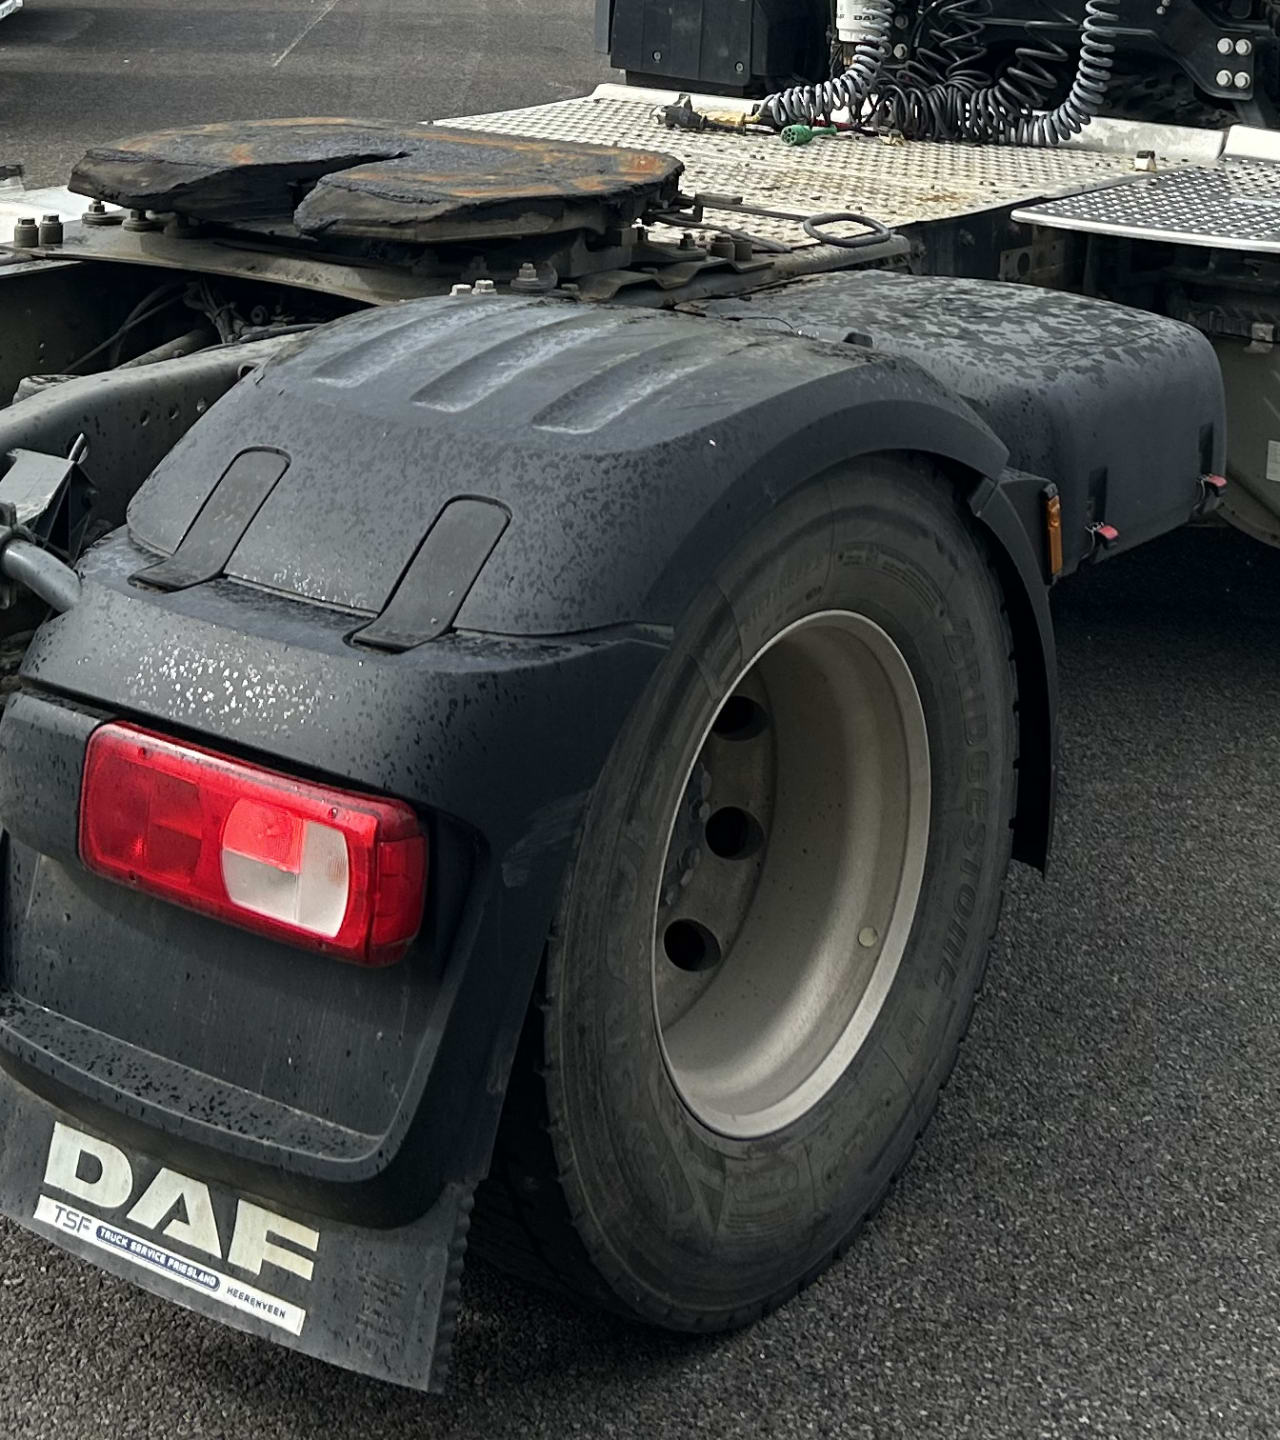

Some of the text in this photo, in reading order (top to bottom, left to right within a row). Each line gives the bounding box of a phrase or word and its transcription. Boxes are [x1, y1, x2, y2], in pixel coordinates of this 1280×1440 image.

[43, 1121, 320, 1282] DAF
[54, 1205, 287, 1319] TSF TRUCK SERVICE FRIESLAND HEERENVEEN
